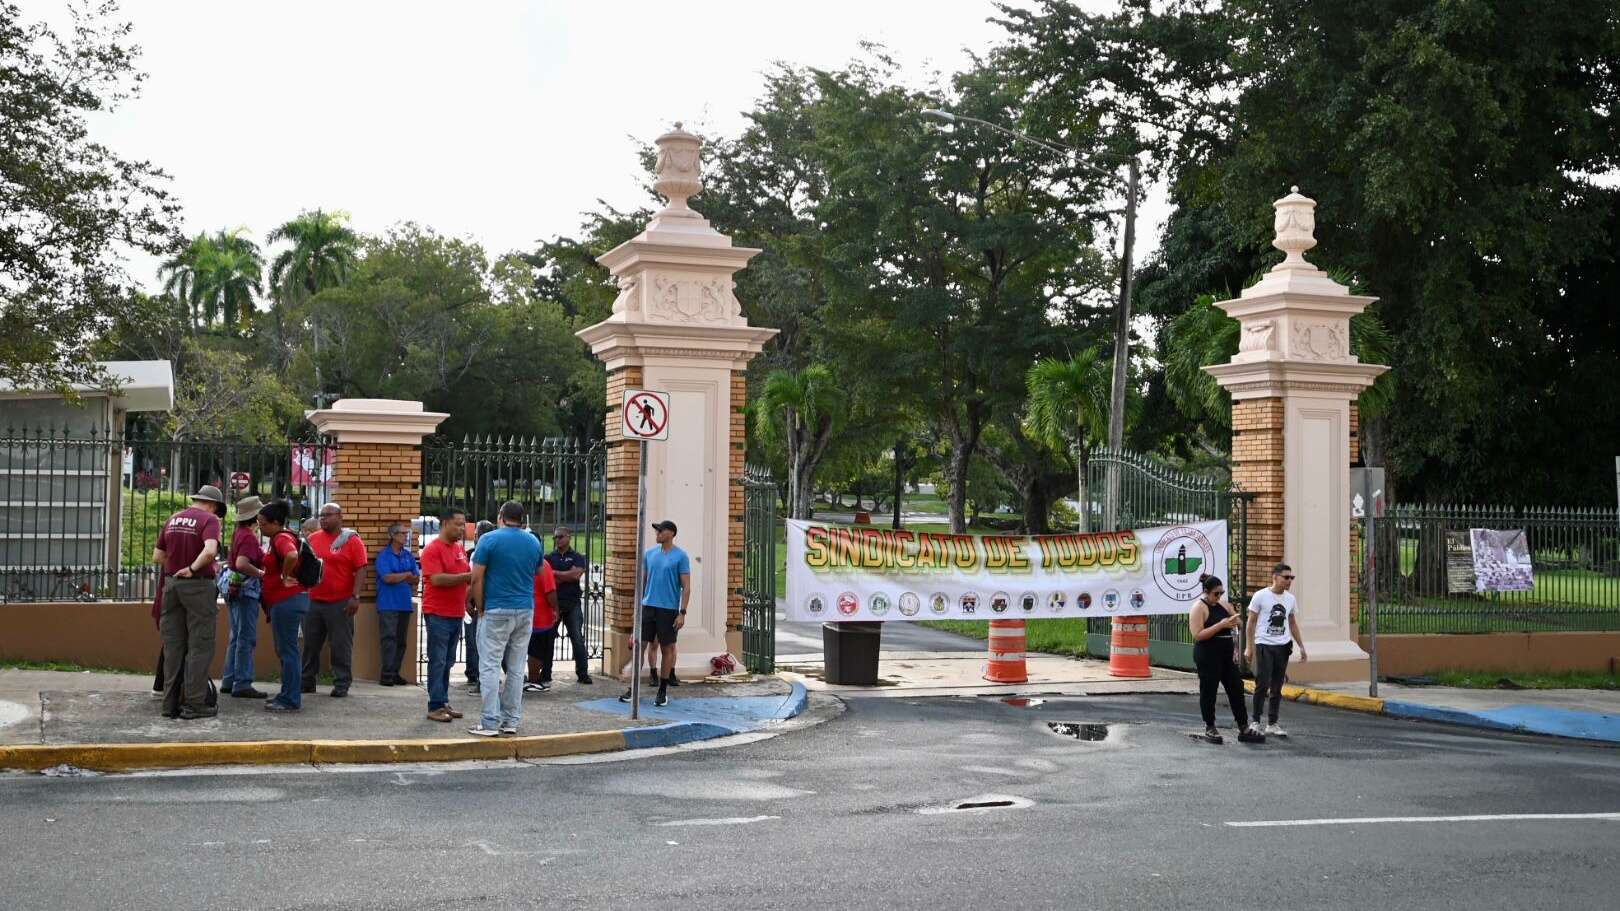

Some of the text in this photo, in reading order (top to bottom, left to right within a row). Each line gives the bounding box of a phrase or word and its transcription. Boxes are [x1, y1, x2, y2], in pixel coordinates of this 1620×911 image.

[169, 517, 197, 527] APPU
[805, 526, 977, 568] SINDICATO
[982, 535, 1029, 568] DE
[1032, 530, 1138, 568] TODOS
